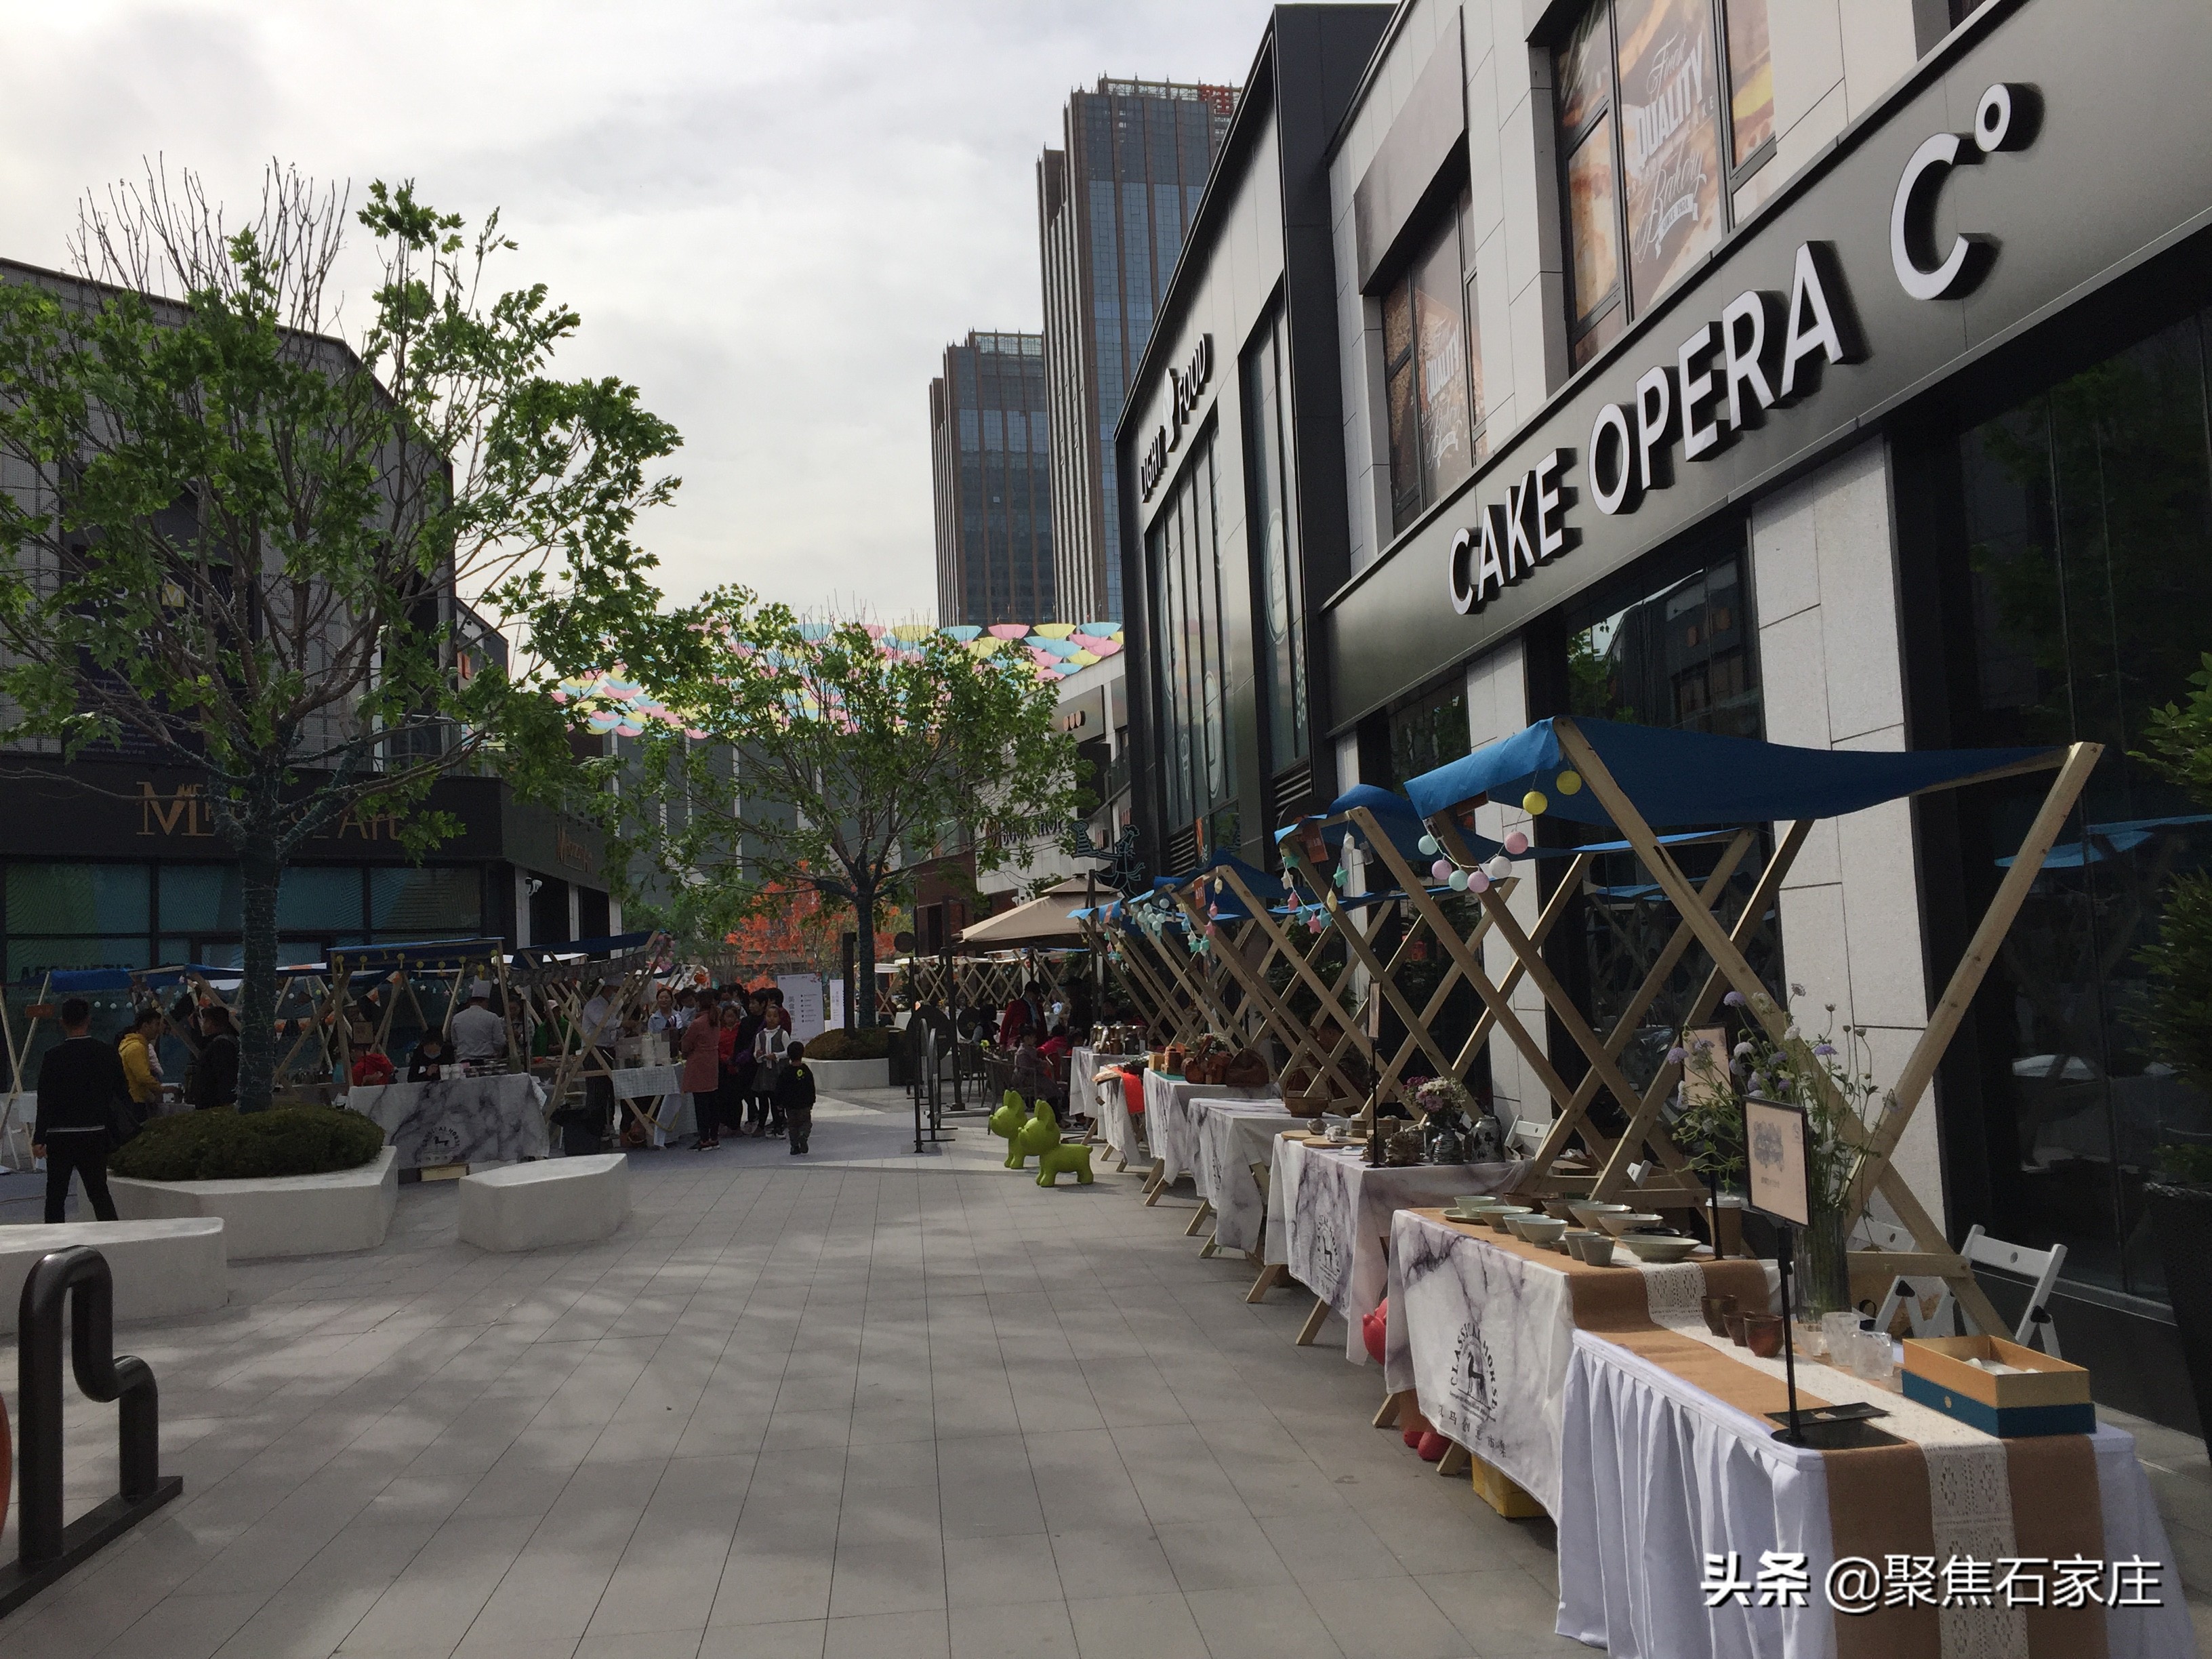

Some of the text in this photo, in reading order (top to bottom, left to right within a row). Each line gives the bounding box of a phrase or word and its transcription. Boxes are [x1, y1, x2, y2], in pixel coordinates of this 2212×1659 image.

[1635, 31, 1702, 171] QUALITY
[1178, 333, 1206, 424] FOOD
[1448, 448, 1564, 615] CAKE
[1588, 241, 1845, 515] OPERA
[337, 804, 398, 840] Art
